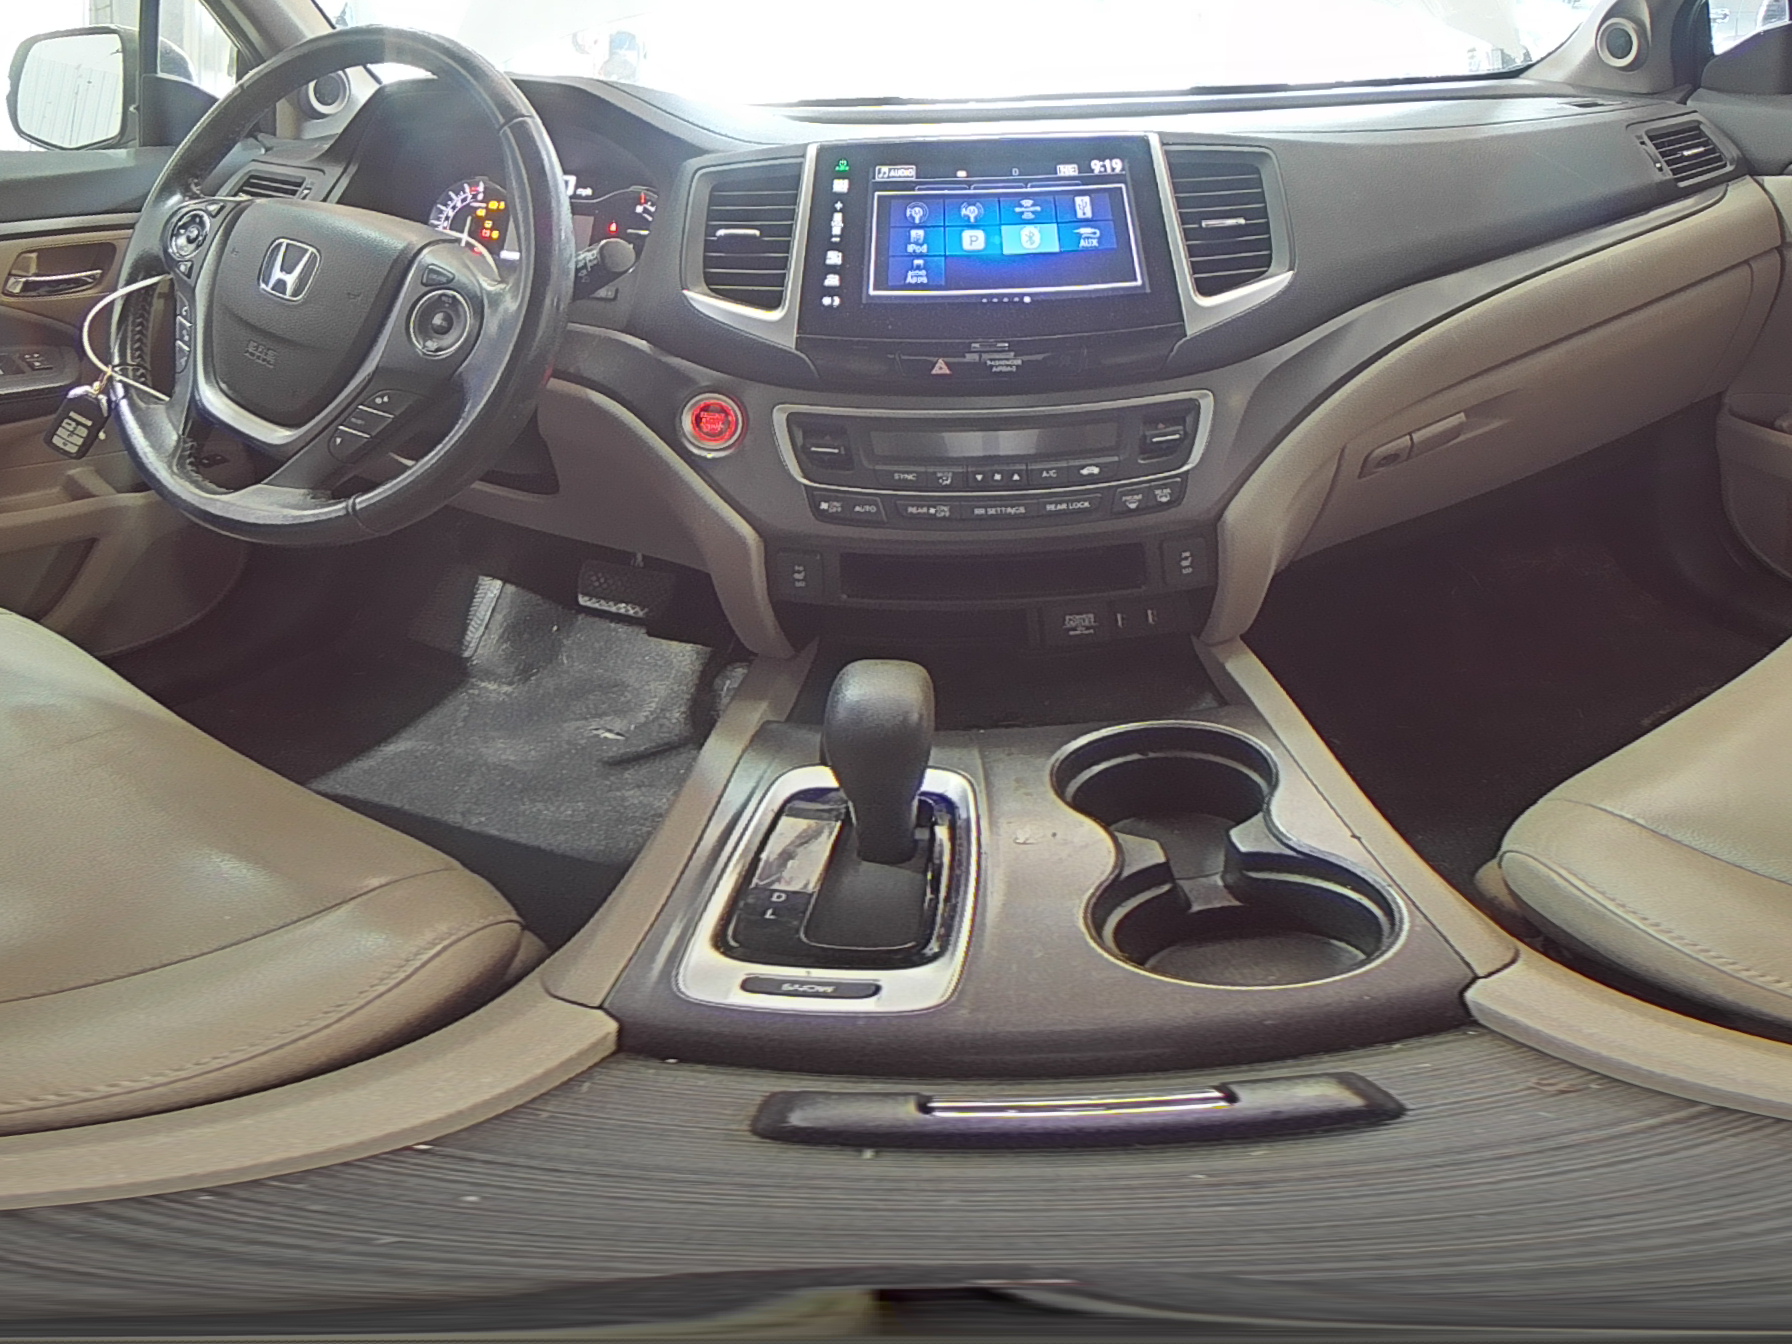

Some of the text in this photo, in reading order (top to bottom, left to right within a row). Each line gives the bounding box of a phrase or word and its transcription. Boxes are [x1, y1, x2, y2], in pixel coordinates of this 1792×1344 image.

[1090, 158, 1122, 173] 9:19
[889, 167, 914, 178] AUDIO
[1078, 238, 1099, 247] AUX
[894, 472, 917, 481] SYNC
[1042, 469, 1058, 478] A/C
[853, 504, 877, 513] AUTO
[907, 505, 928, 514] REAR
[974, 505, 1026, 516] RR SETTINGS
[1046, 500, 1090, 512] REAR LOCK
[770, 891, 786, 903] D
[764, 907, 777, 919] L
